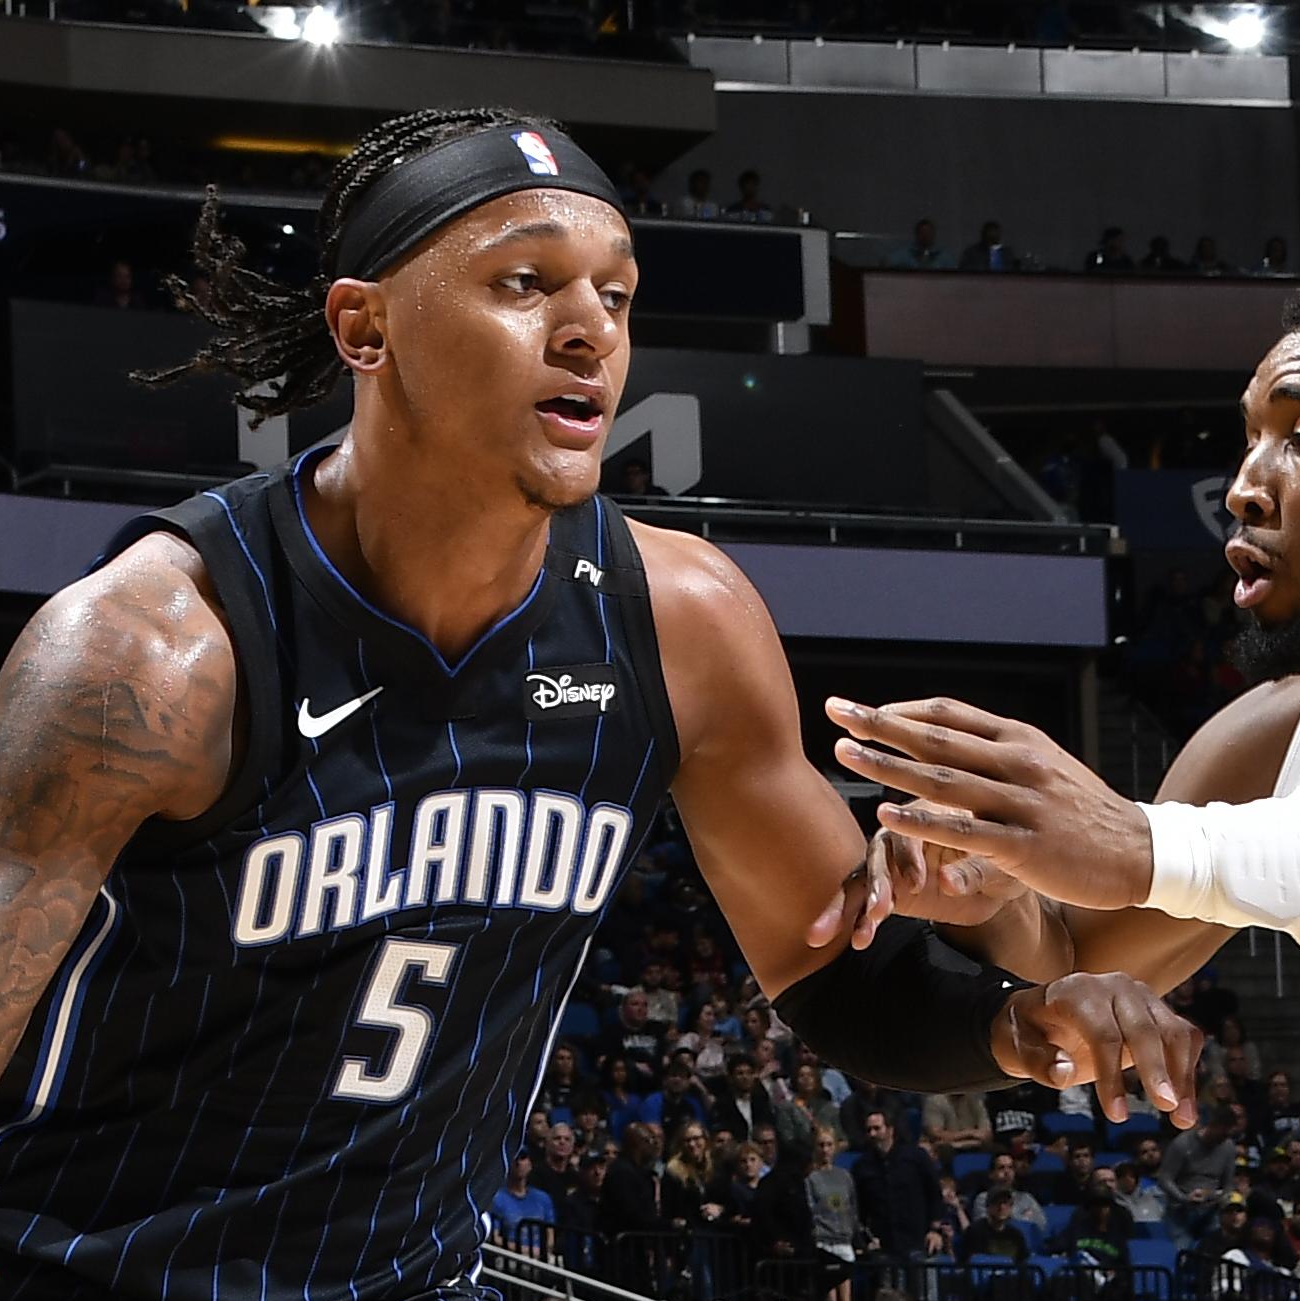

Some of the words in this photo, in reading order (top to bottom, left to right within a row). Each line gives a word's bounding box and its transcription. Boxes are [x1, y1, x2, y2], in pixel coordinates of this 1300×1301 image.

[574, 559, 603, 587] PW
[231, 786, 634, 948] ORLANDO
[330, 936, 462, 1106] 5
